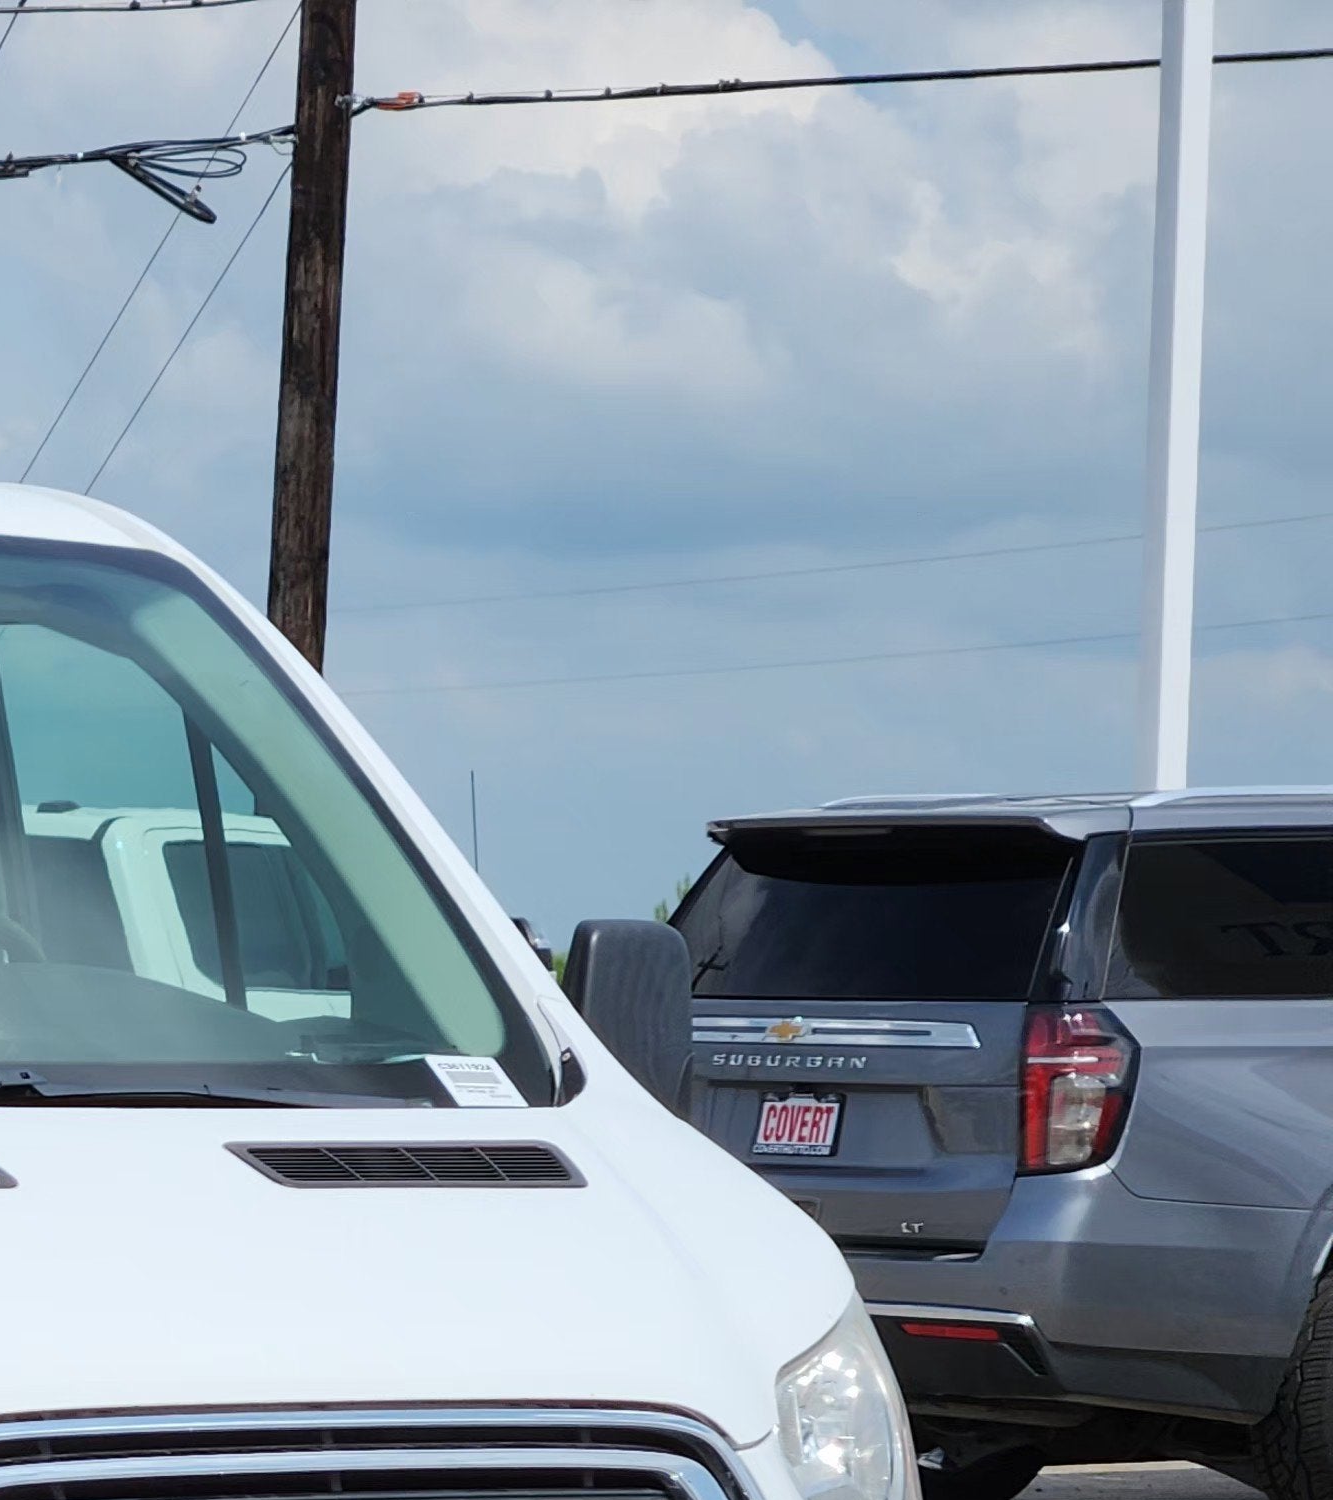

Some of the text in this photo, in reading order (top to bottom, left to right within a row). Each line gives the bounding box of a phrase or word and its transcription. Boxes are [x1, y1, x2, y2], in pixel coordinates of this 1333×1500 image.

[712, 1053, 867, 1069] SUBURBAN
[763, 1104, 835, 1143] COVERT
[900, 1222, 924, 1233] LT
